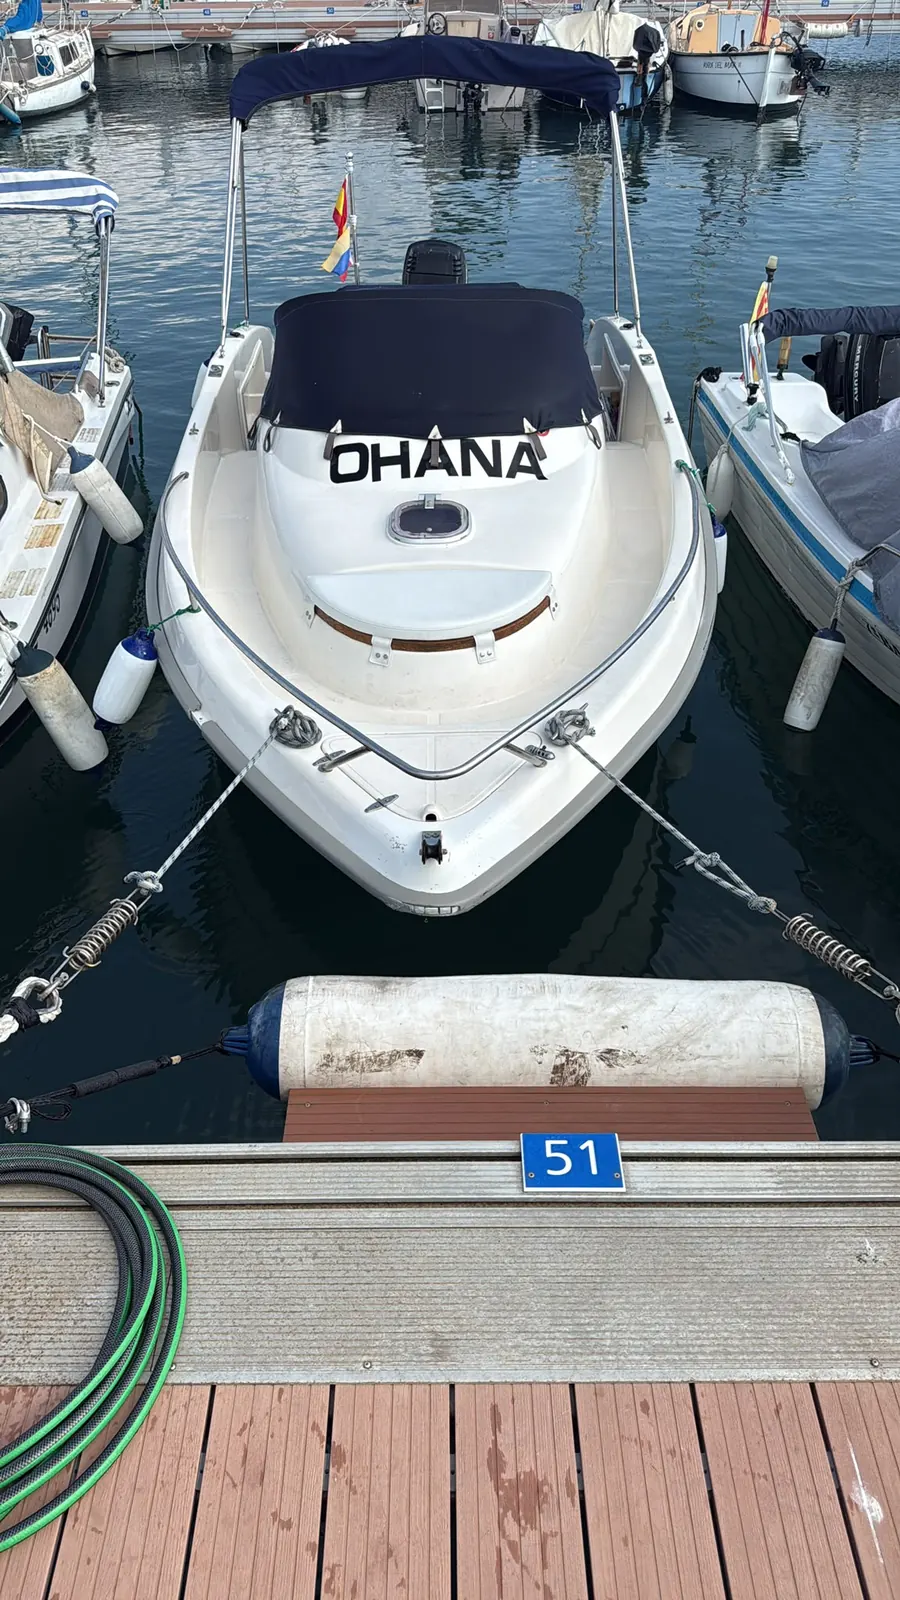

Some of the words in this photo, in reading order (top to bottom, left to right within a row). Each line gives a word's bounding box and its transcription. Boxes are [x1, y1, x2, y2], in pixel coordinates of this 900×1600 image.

[853, 345, 862, 402] MERCURY
[330, 439, 549, 484] OHANA
[545, 1140, 598, 1176] 51
